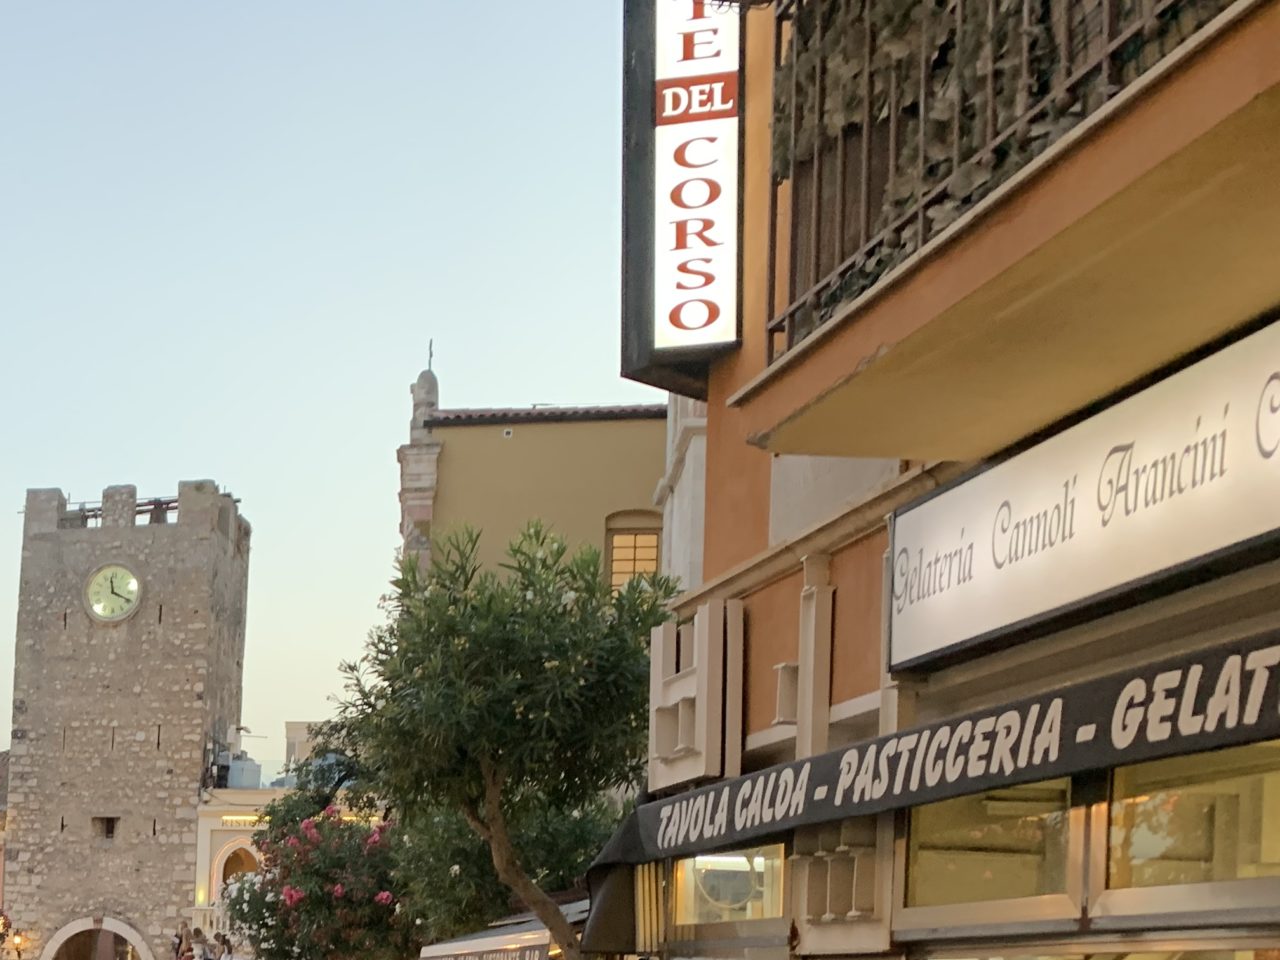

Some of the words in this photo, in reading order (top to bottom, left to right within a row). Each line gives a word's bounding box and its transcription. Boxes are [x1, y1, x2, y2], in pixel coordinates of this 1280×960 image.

[661, 82, 734, 117] DEL
[668, 136, 724, 331] CORSO
[892, 526, 974, 615] Gelateria
[991, 473, 1078, 570] Cannoli
[1096, 402, 1230, 528] Arancini
[656, 784, 728, 850] TAVOLA
[734, 762, 812, 831] CALDA
[834, 697, 1063, 807] PASTICCERIA
[1111, 645, 1280, 750] GELAT
